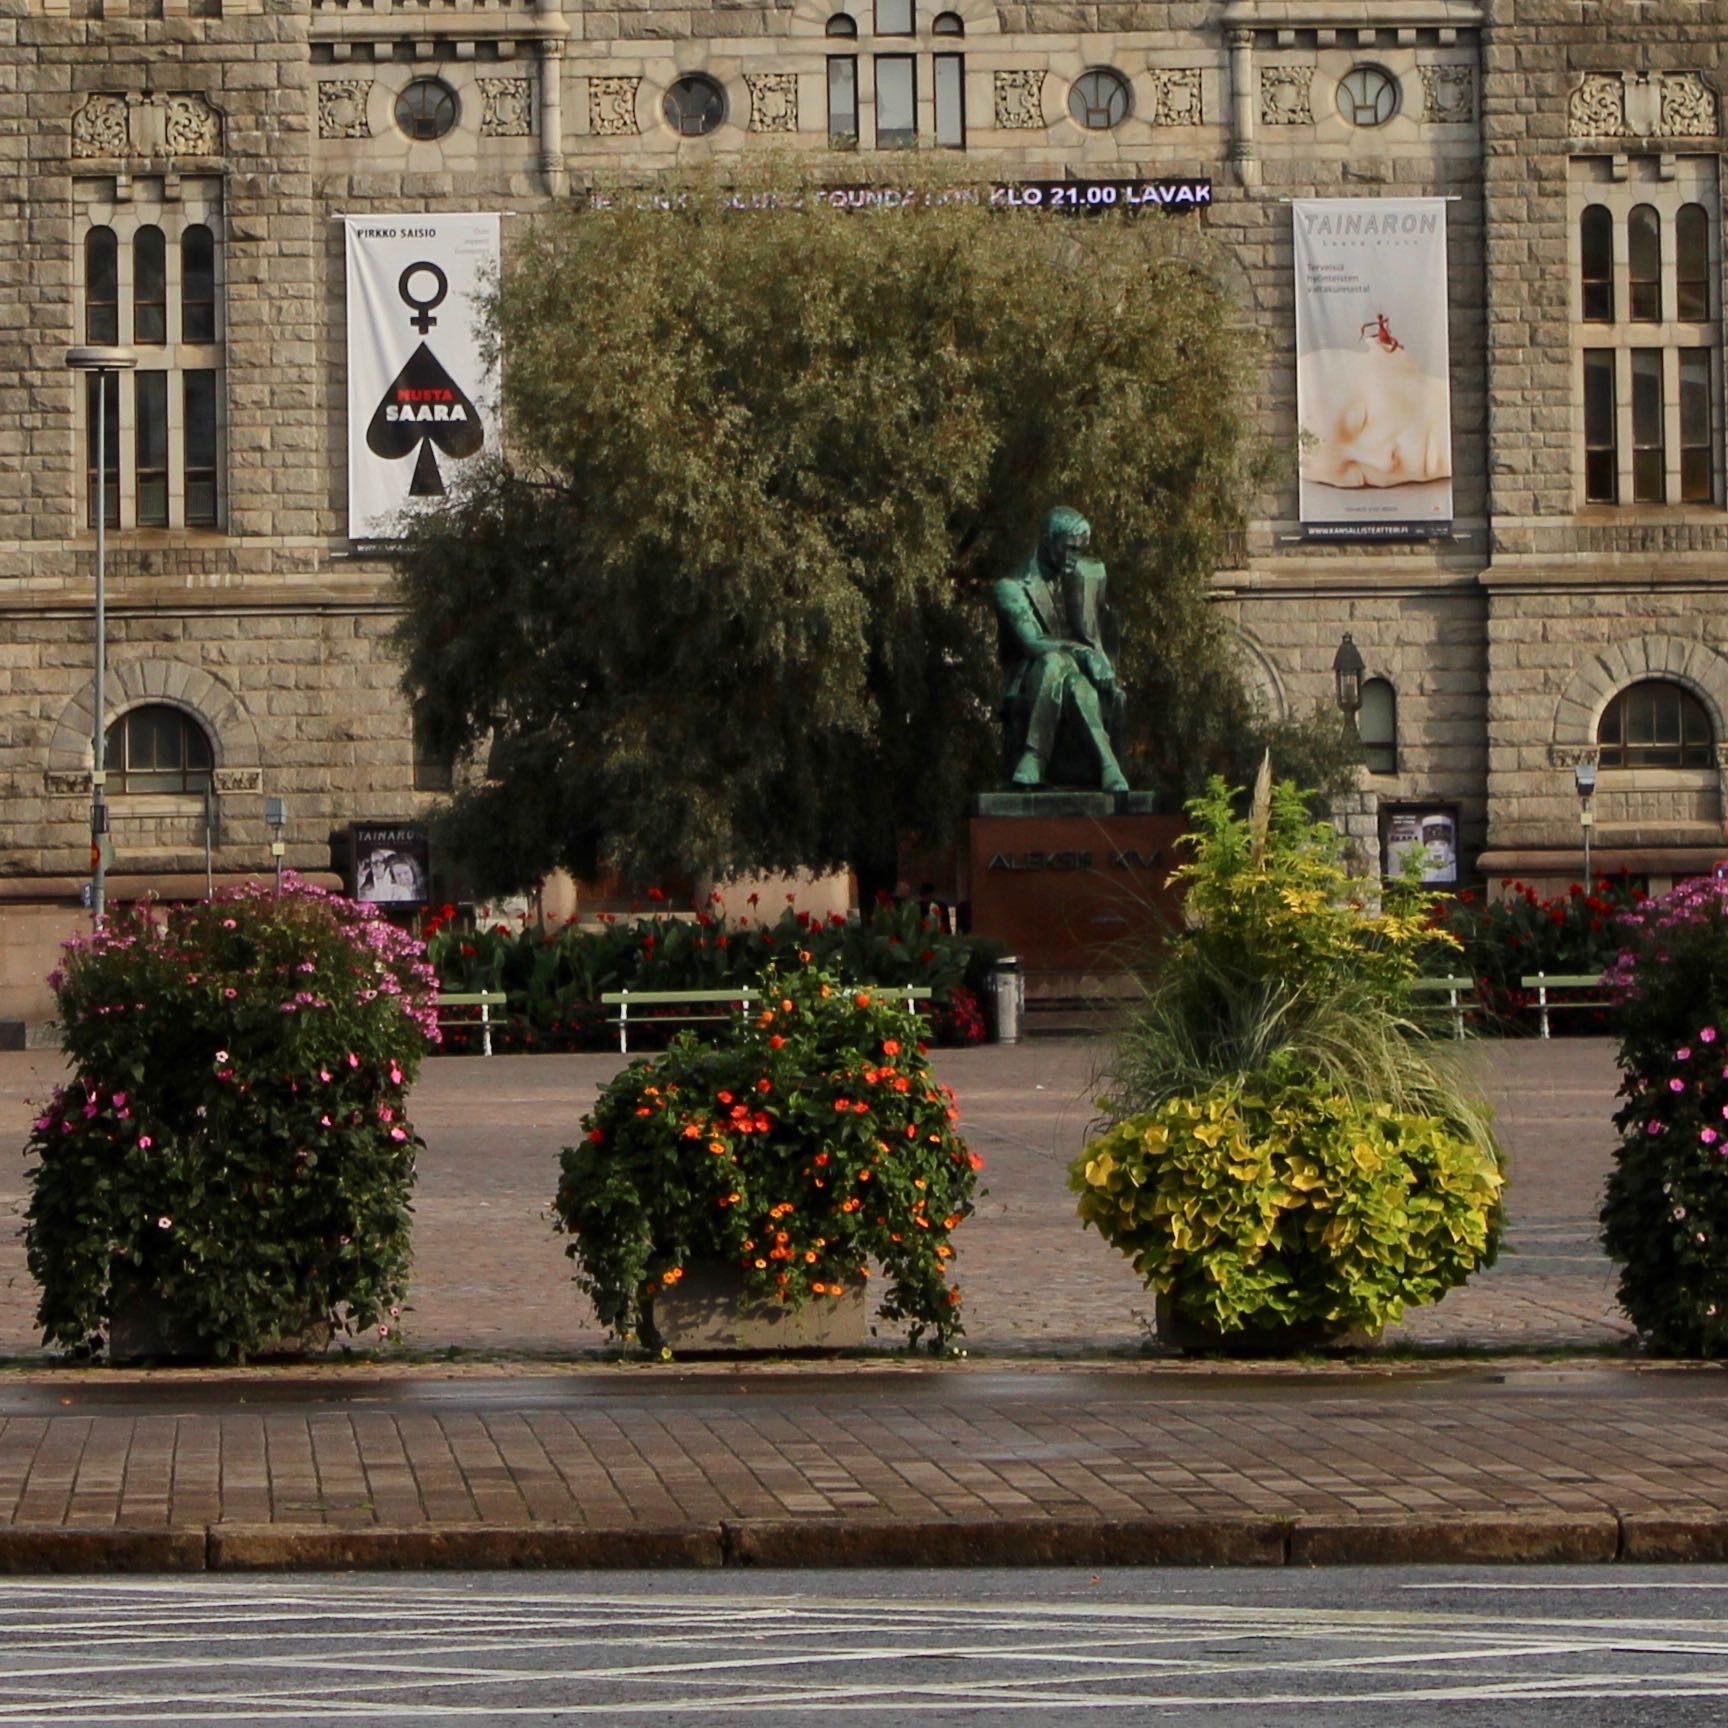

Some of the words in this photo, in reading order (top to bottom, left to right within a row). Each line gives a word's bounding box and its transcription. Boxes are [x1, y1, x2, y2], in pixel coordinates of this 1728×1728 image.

[991, 188, 1042, 205] KLO
[1050, 186, 1116, 204] 21.00
[1126, 185, 1210, 203] LAVAK
[1305, 213, 1437, 235] TAINARON
[357, 228, 397, 239] PIRKKO
[401, 228, 437, 238] SAISIO
[386, 404, 467, 421] SAARA
[1308, 525, 1409, 535] WWW.KANSALLISTEATTERI.FI
